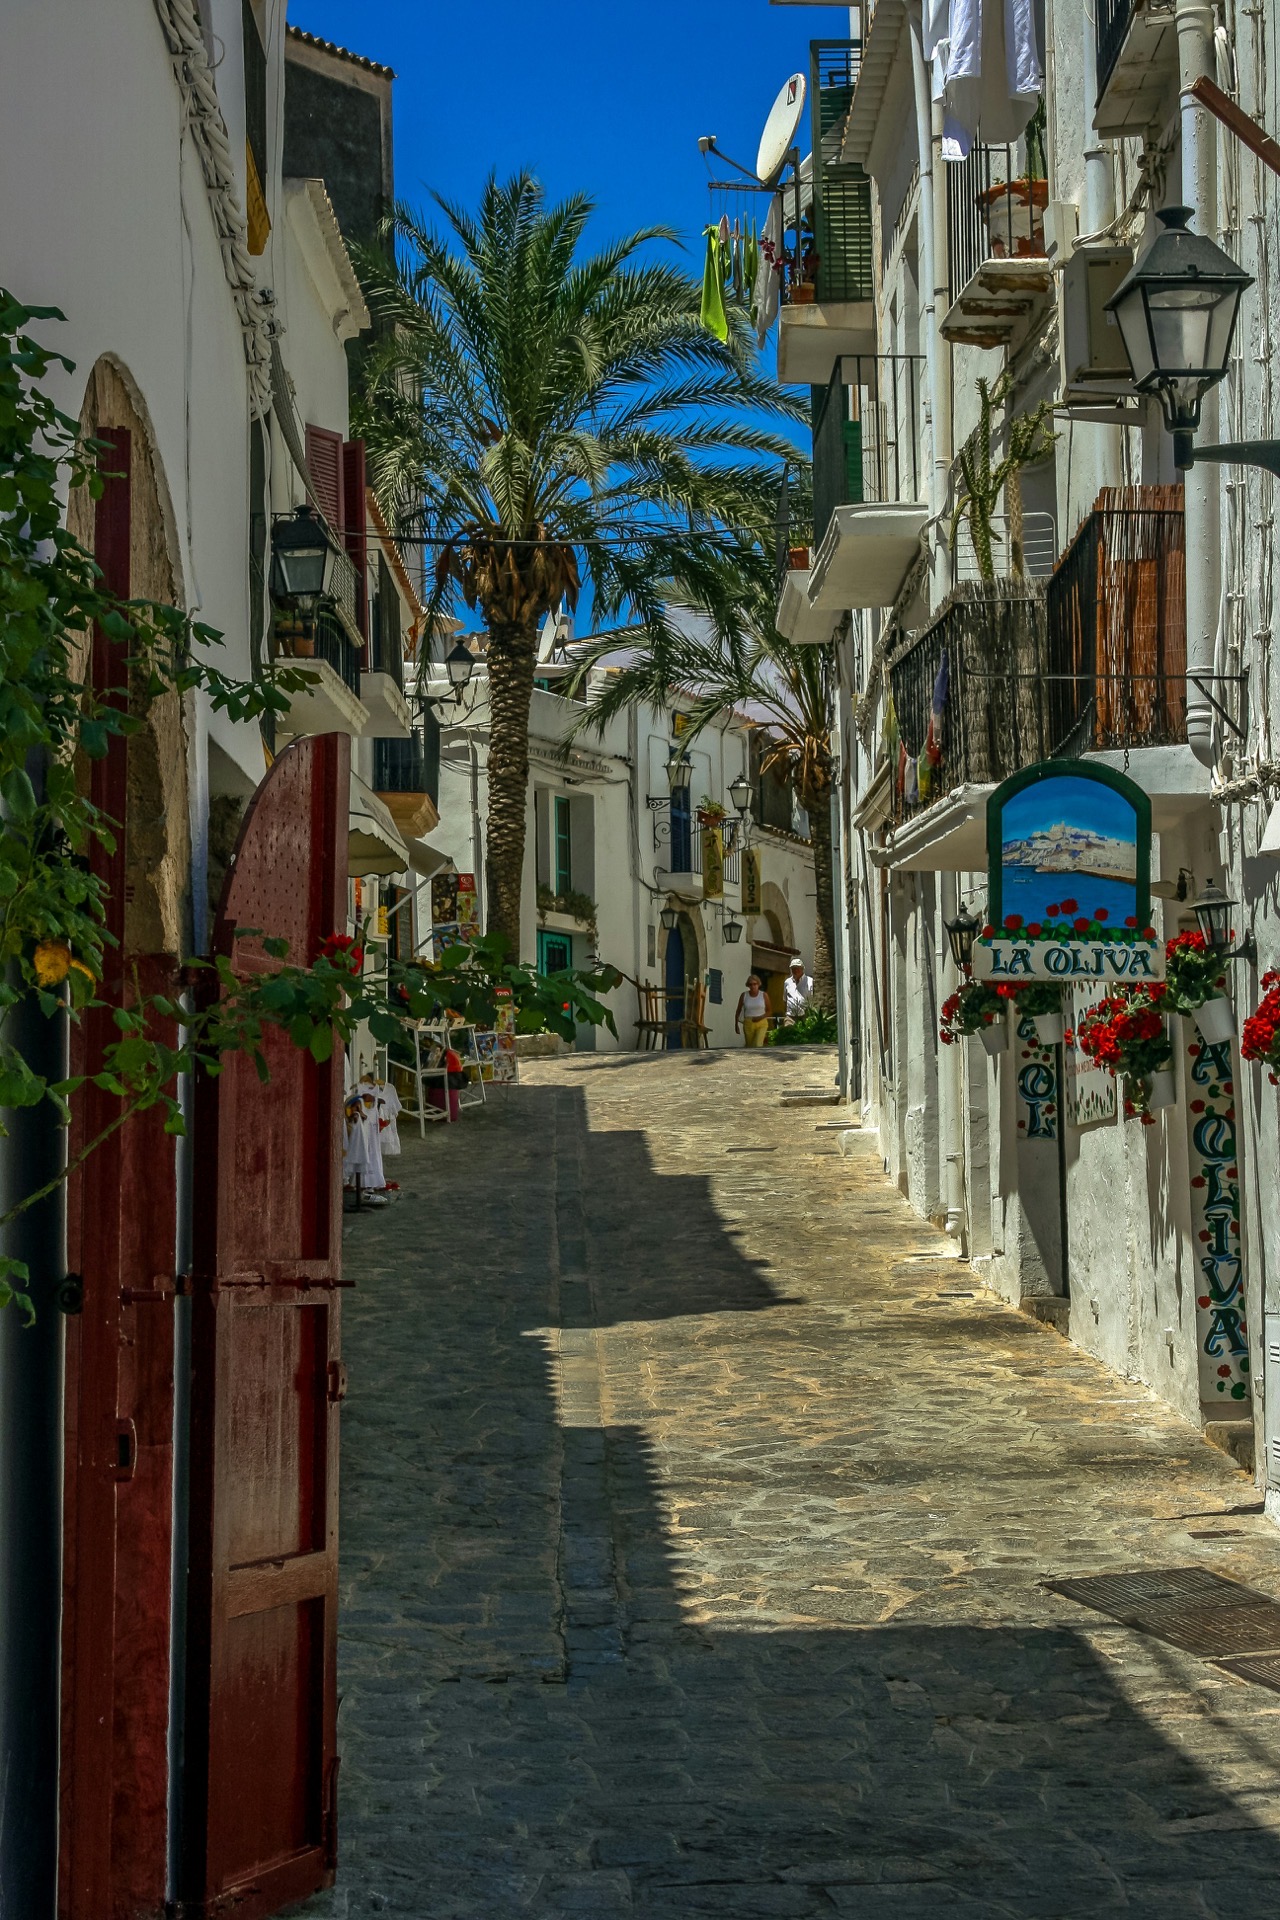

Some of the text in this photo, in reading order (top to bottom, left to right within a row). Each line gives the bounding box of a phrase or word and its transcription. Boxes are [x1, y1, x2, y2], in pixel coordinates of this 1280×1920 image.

[990, 947, 1153, 976] LA OLIVA
[1193, 1114, 1249, 1356] OLIVA
